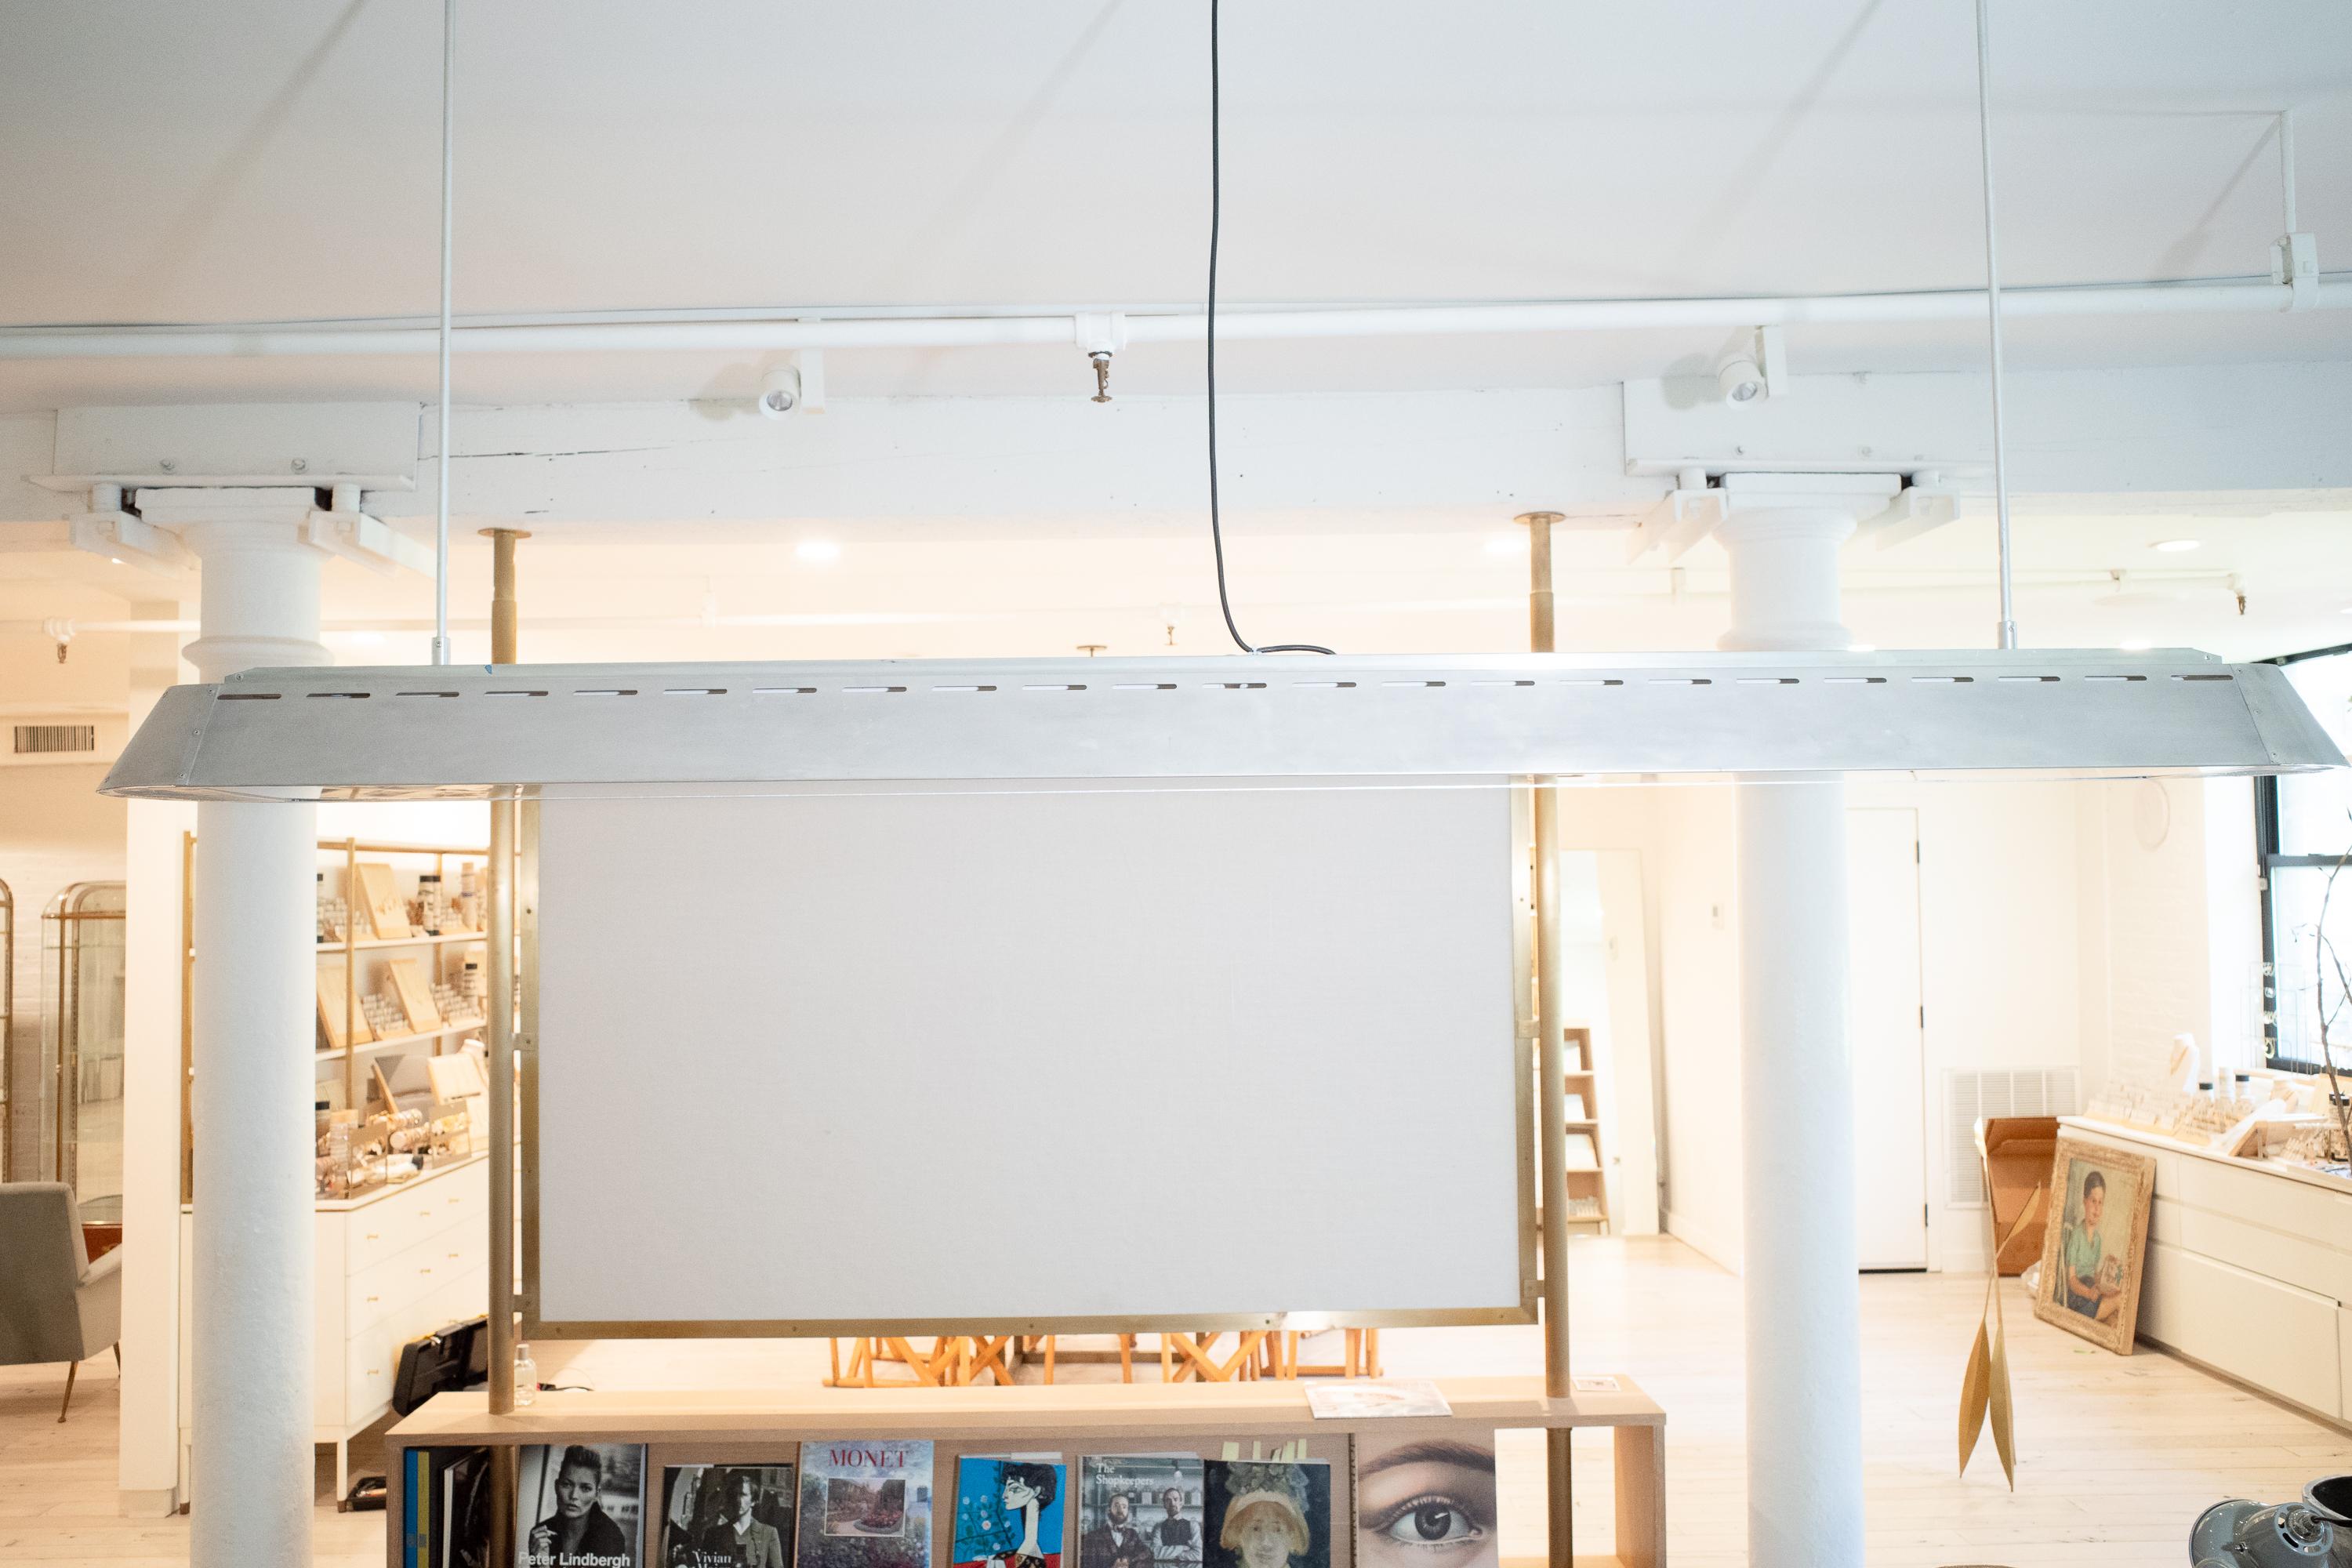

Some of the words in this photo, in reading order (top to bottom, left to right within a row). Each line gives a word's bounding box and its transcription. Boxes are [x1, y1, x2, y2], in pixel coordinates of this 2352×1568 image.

[829, 1449, 909, 1468] MONET
[1096, 1462, 1114, 1473] The
[1096, 1474, 1155, 1488] Shopkeepers
[518, 1552, 556, 1565] Peter
[559, 1552, 630, 1568] Lindbergh
[692, 1549, 731, 1563] Vivian
